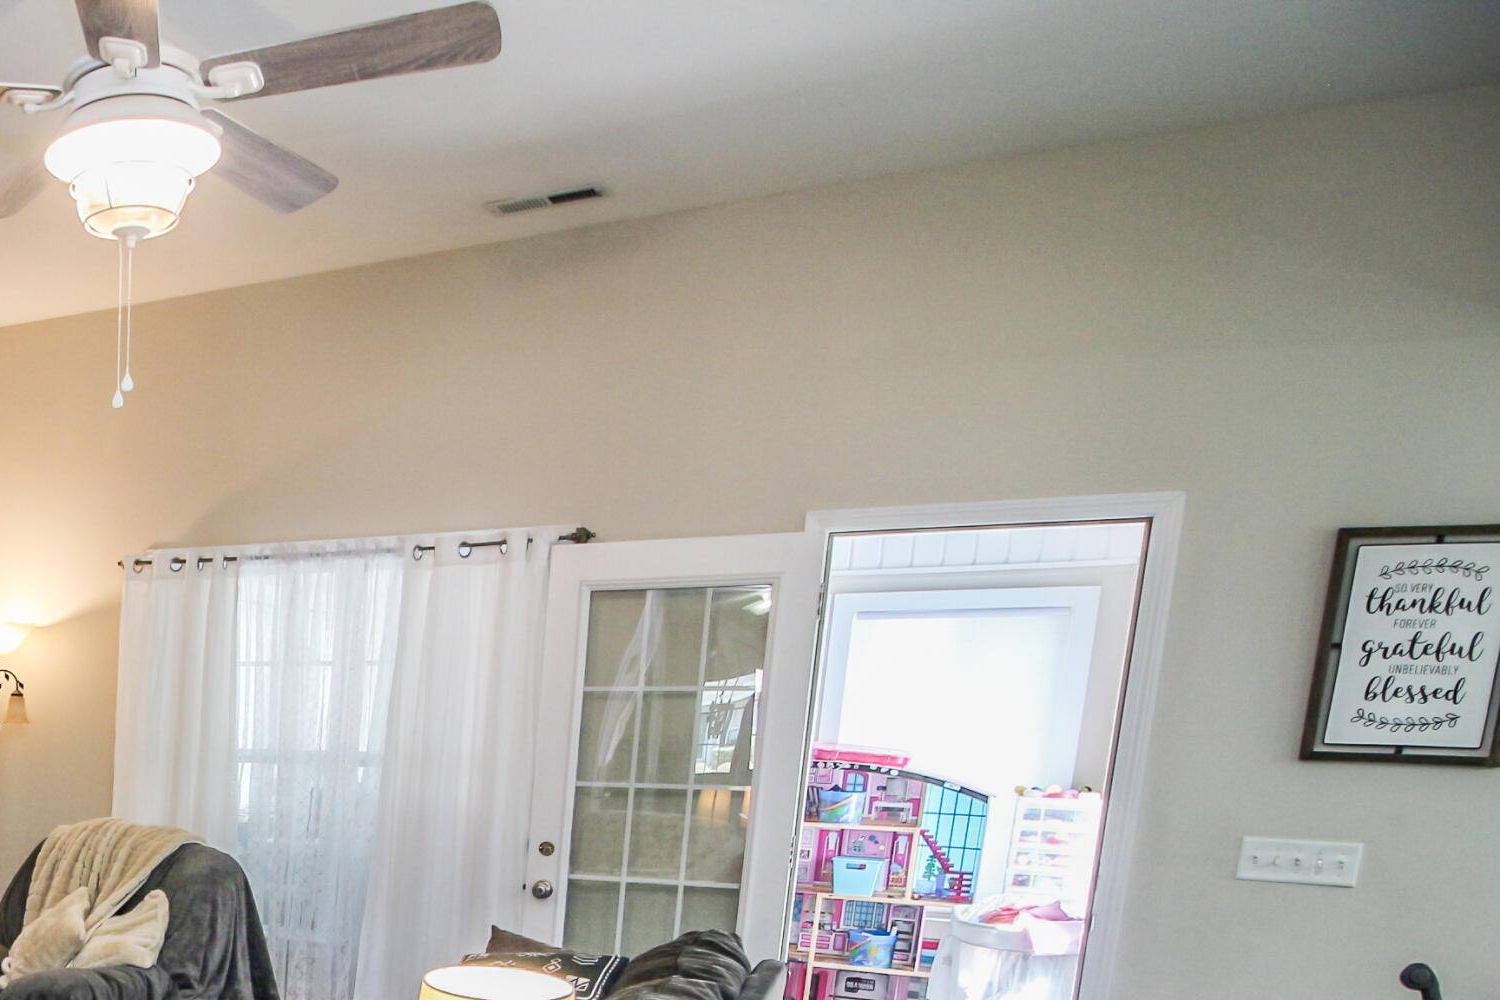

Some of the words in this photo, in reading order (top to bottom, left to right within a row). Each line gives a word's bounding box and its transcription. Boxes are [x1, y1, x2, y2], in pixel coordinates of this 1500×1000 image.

[1394, 583, 1408, 594] SO
[1410, 583, 1434, 593] VERY
[1365, 586, 1493, 616] thankful
[1393, 619, 1437, 629] FOREVER
[1359, 630, 1485, 667] grateful
[1388, 664, 1460, 675] UNBELIEVABLY
[1363, 675, 1468, 705] blessed
